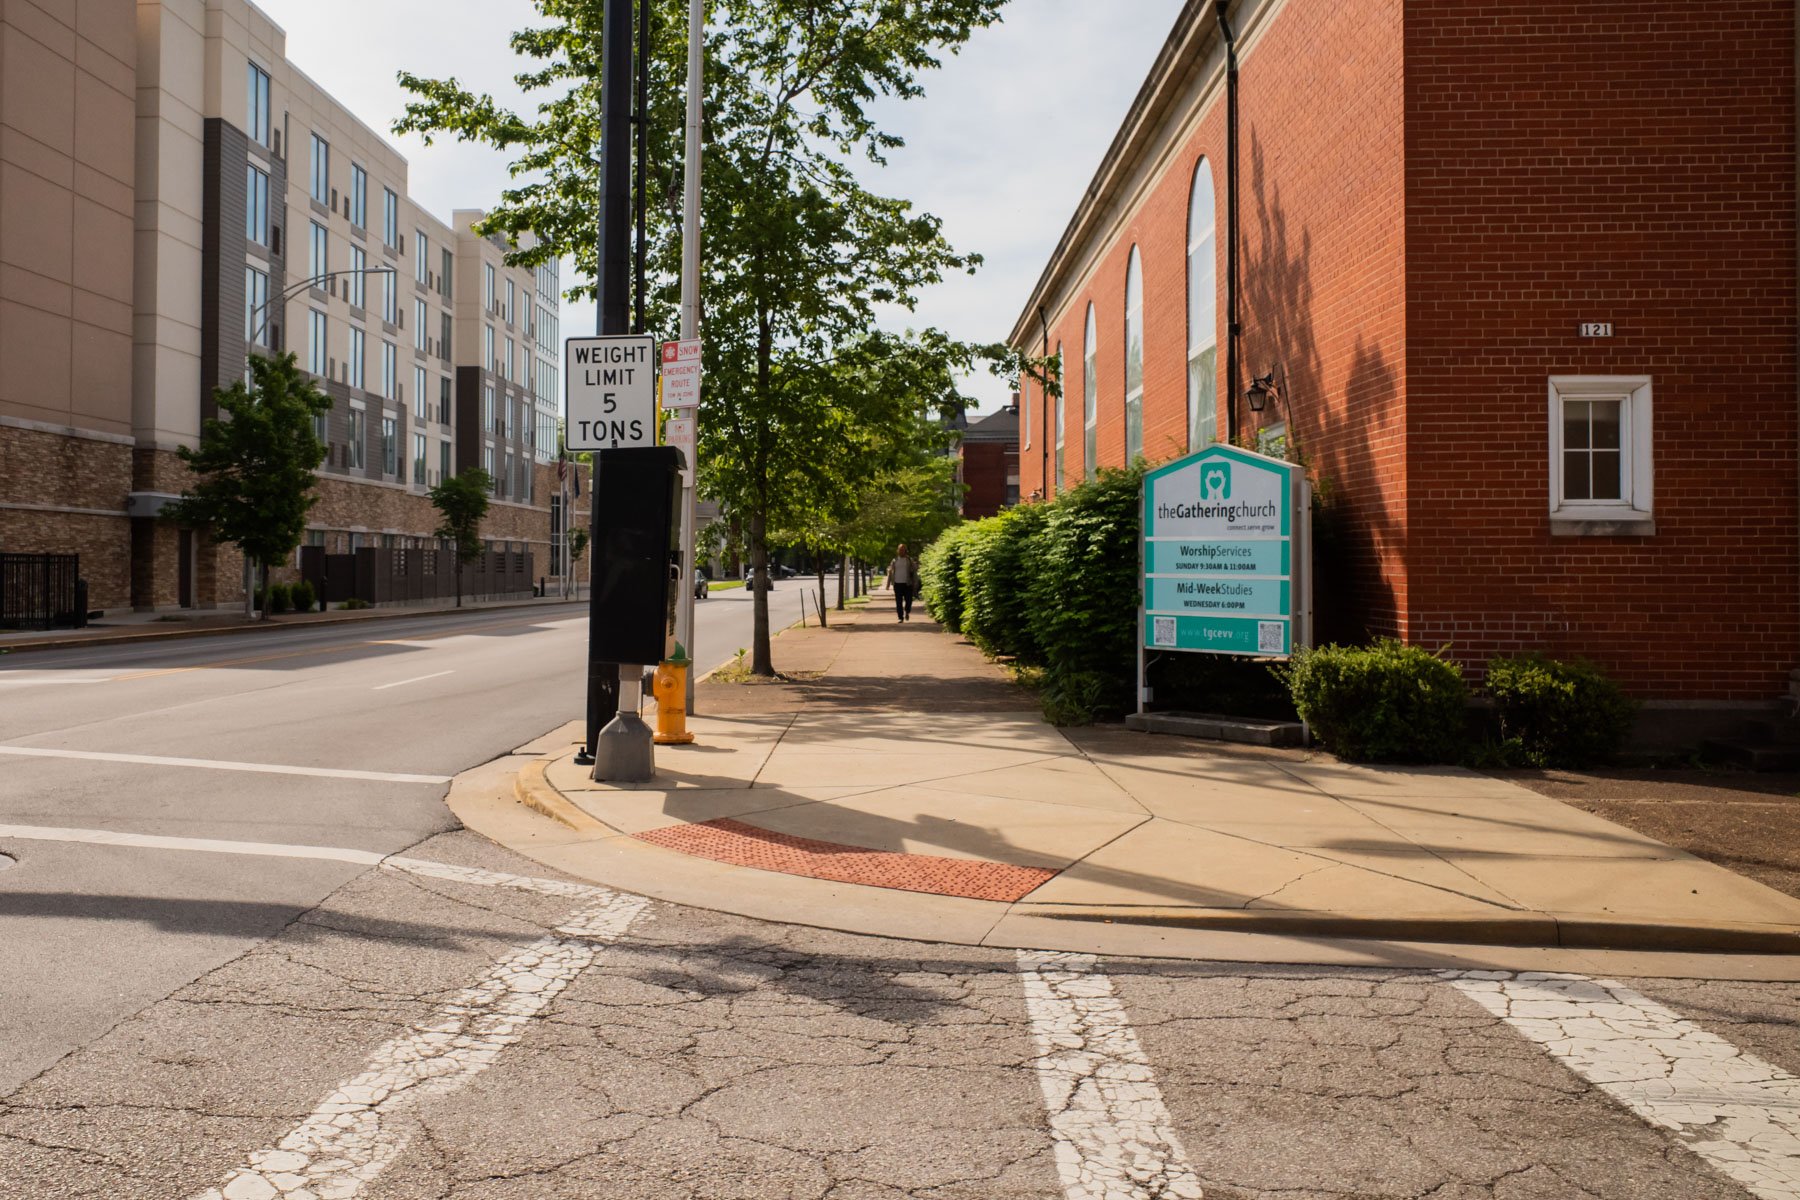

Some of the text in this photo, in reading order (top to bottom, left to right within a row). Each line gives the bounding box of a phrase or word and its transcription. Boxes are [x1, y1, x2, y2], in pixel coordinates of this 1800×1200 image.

[1584, 324, 1609, 336] 121
[575, 346, 648, 364] WEIGHT
[679, 345, 699, 357] SNOW
[585, 369, 635, 386] LIMIT
[663, 366, 698, 377] EMERGENCY
[671, 379, 690, 388] ROUTE
[603, 393, 617, 413] 5
[578, 419, 643, 441] TONS
[666, 434, 691, 444] PARKING
[1158, 500, 1276, 522] theGatheringchurch
[1179, 544, 1252, 560] WorshipServices
[1175, 562, 1257, 571] SUNDAY 9:30AM & 11:00AM
[1176, 582, 1253, 596] Mid-WeekStudies
[1183, 600, 1246, 609] WEDNESDAY 6:00PM
